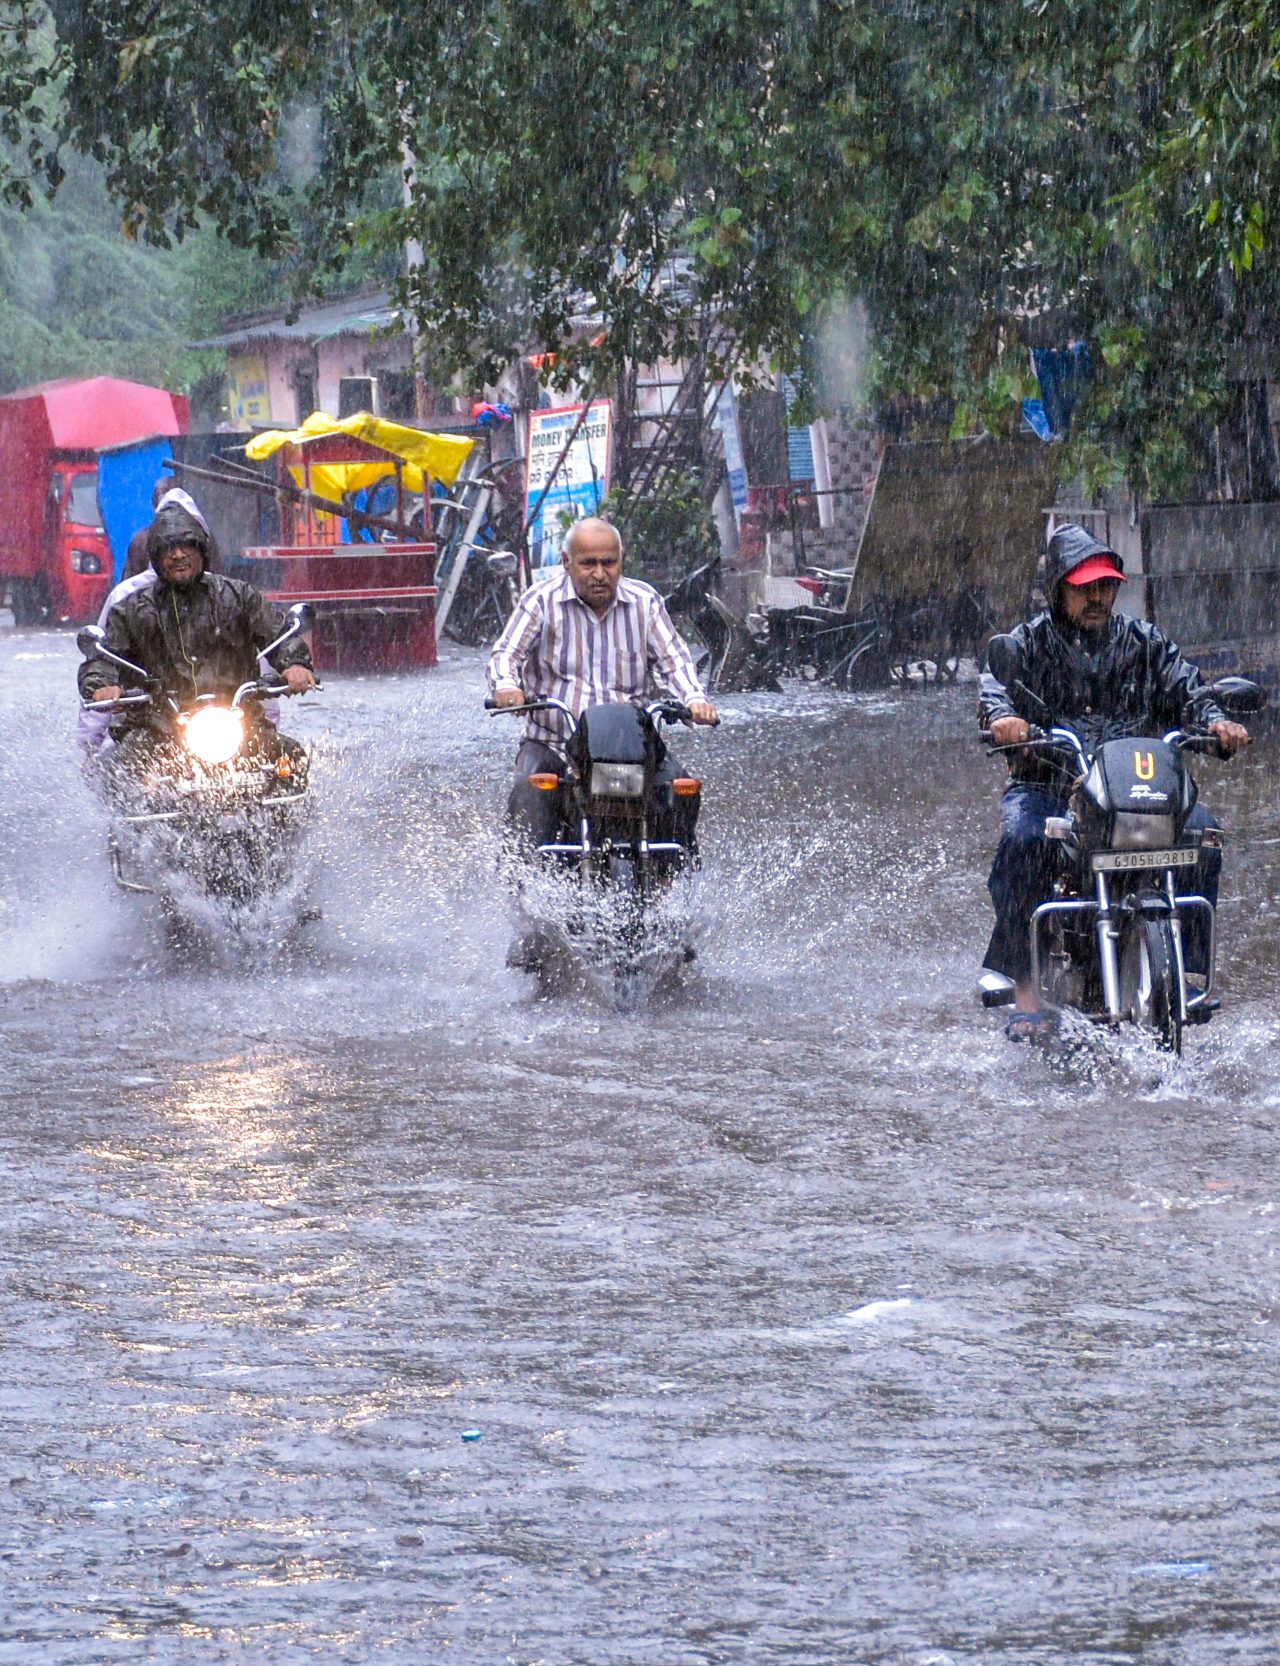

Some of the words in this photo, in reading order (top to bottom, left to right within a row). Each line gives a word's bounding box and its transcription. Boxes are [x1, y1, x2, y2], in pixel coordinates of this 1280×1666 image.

[532, 430, 562, 448] MONEY
[565, 424, 607, 442] TANSFER
[1133, 751, 1155, 781] U
